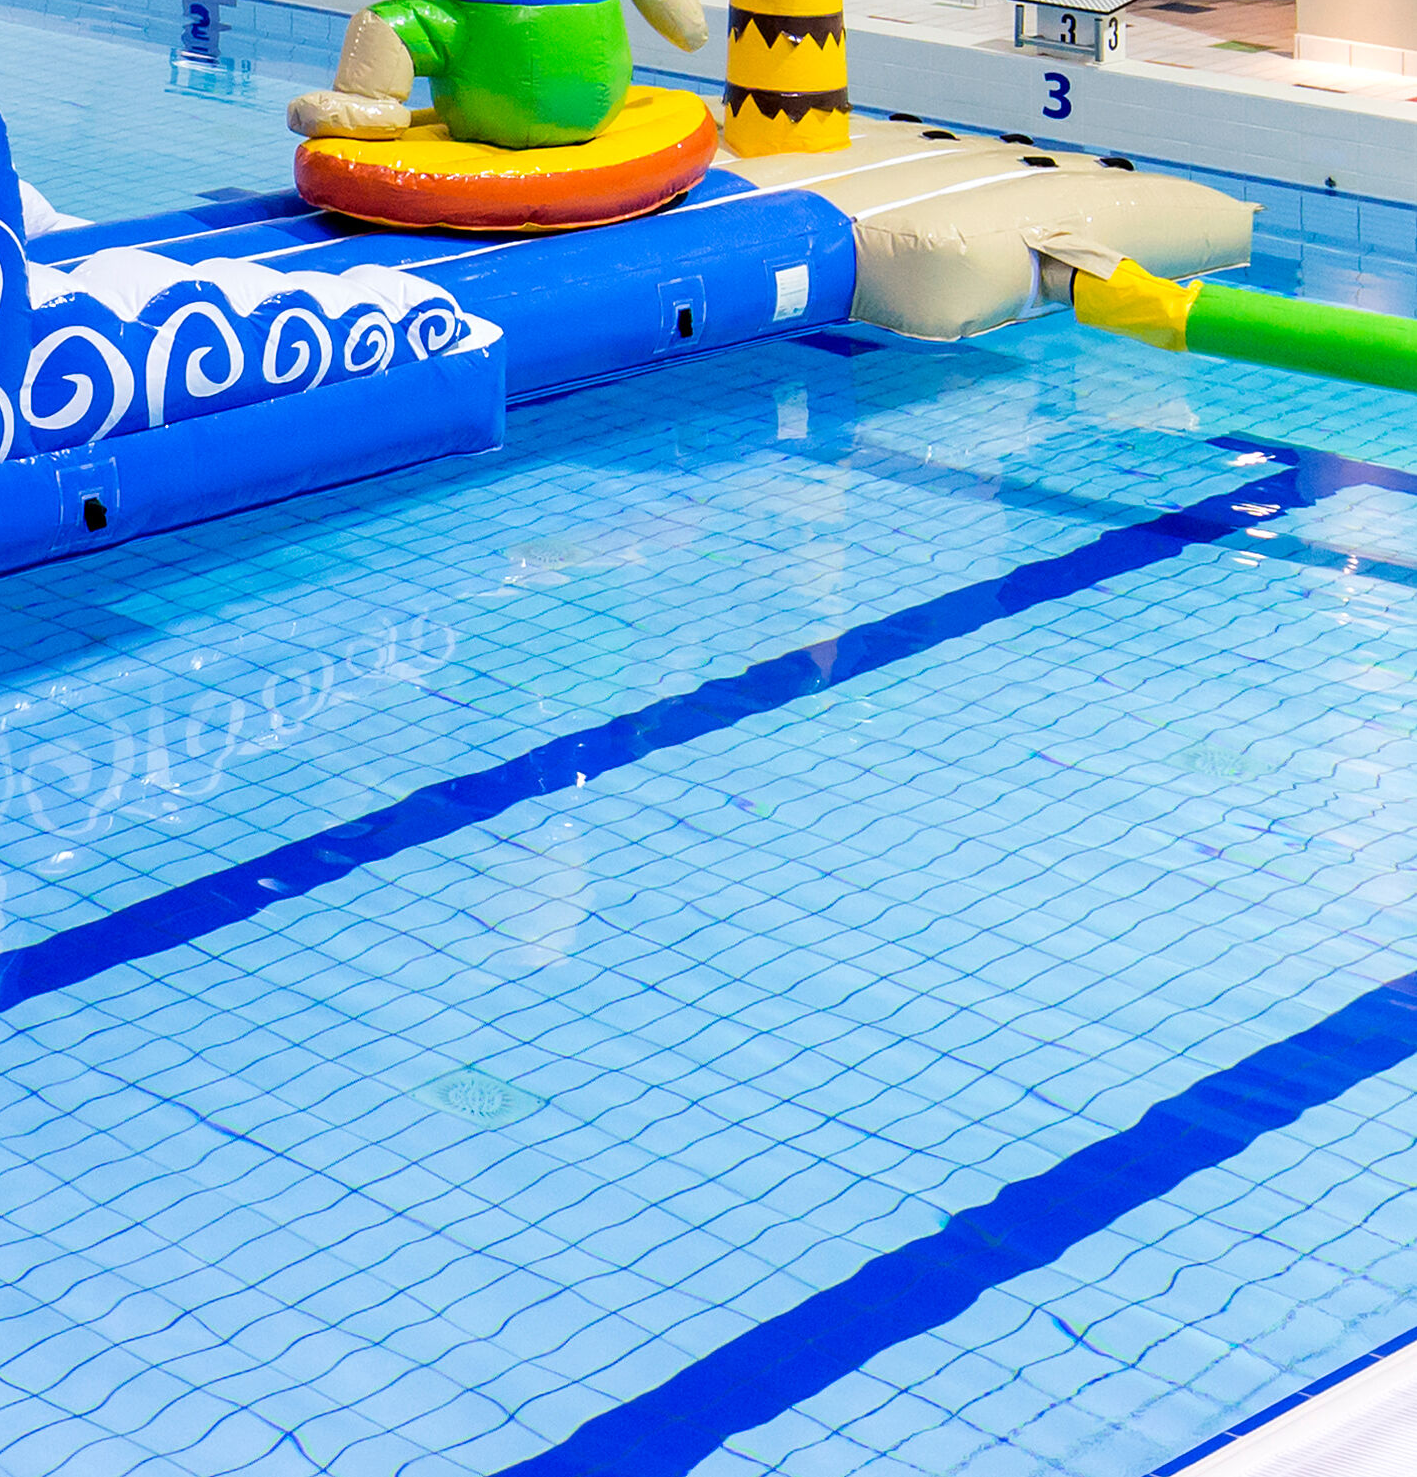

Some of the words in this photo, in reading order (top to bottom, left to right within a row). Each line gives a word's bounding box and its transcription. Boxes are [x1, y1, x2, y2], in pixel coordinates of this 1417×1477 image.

[1060, 13, 1076, 45] 3
[1108, 16, 1119, 51] 3
[1042, 72, 1072, 120] 3
